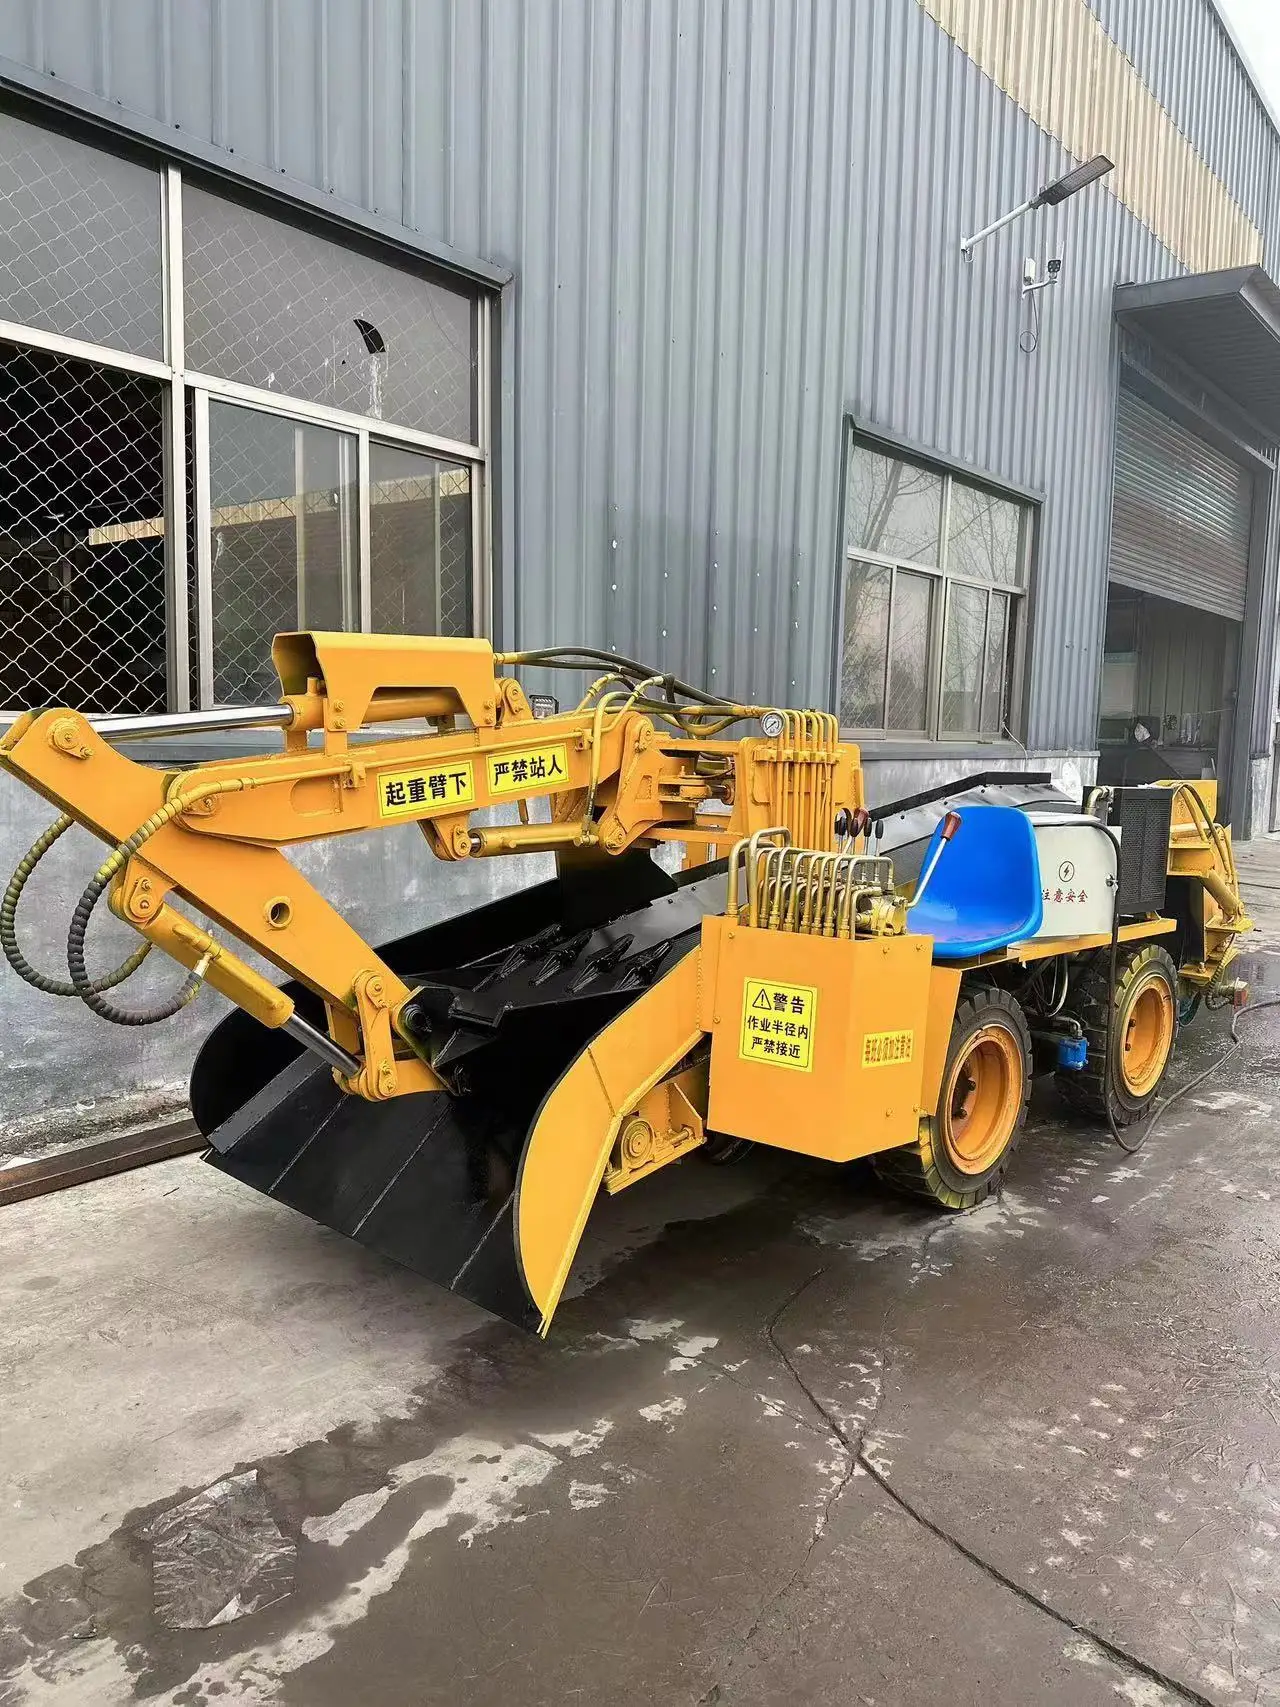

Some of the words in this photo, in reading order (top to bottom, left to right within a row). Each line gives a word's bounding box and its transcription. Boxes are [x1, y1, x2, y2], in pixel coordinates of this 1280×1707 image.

[494, 754, 562, 785] 严禁站人
[386, 772, 467, 807] 起重臂下
[1041, 888, 1088, 903] 注意安全
[773, 992, 805, 1014] 警告
[747, 1015, 808, 1039] 作业半径内
[751, 1036, 801, 1059] 严禁接近
